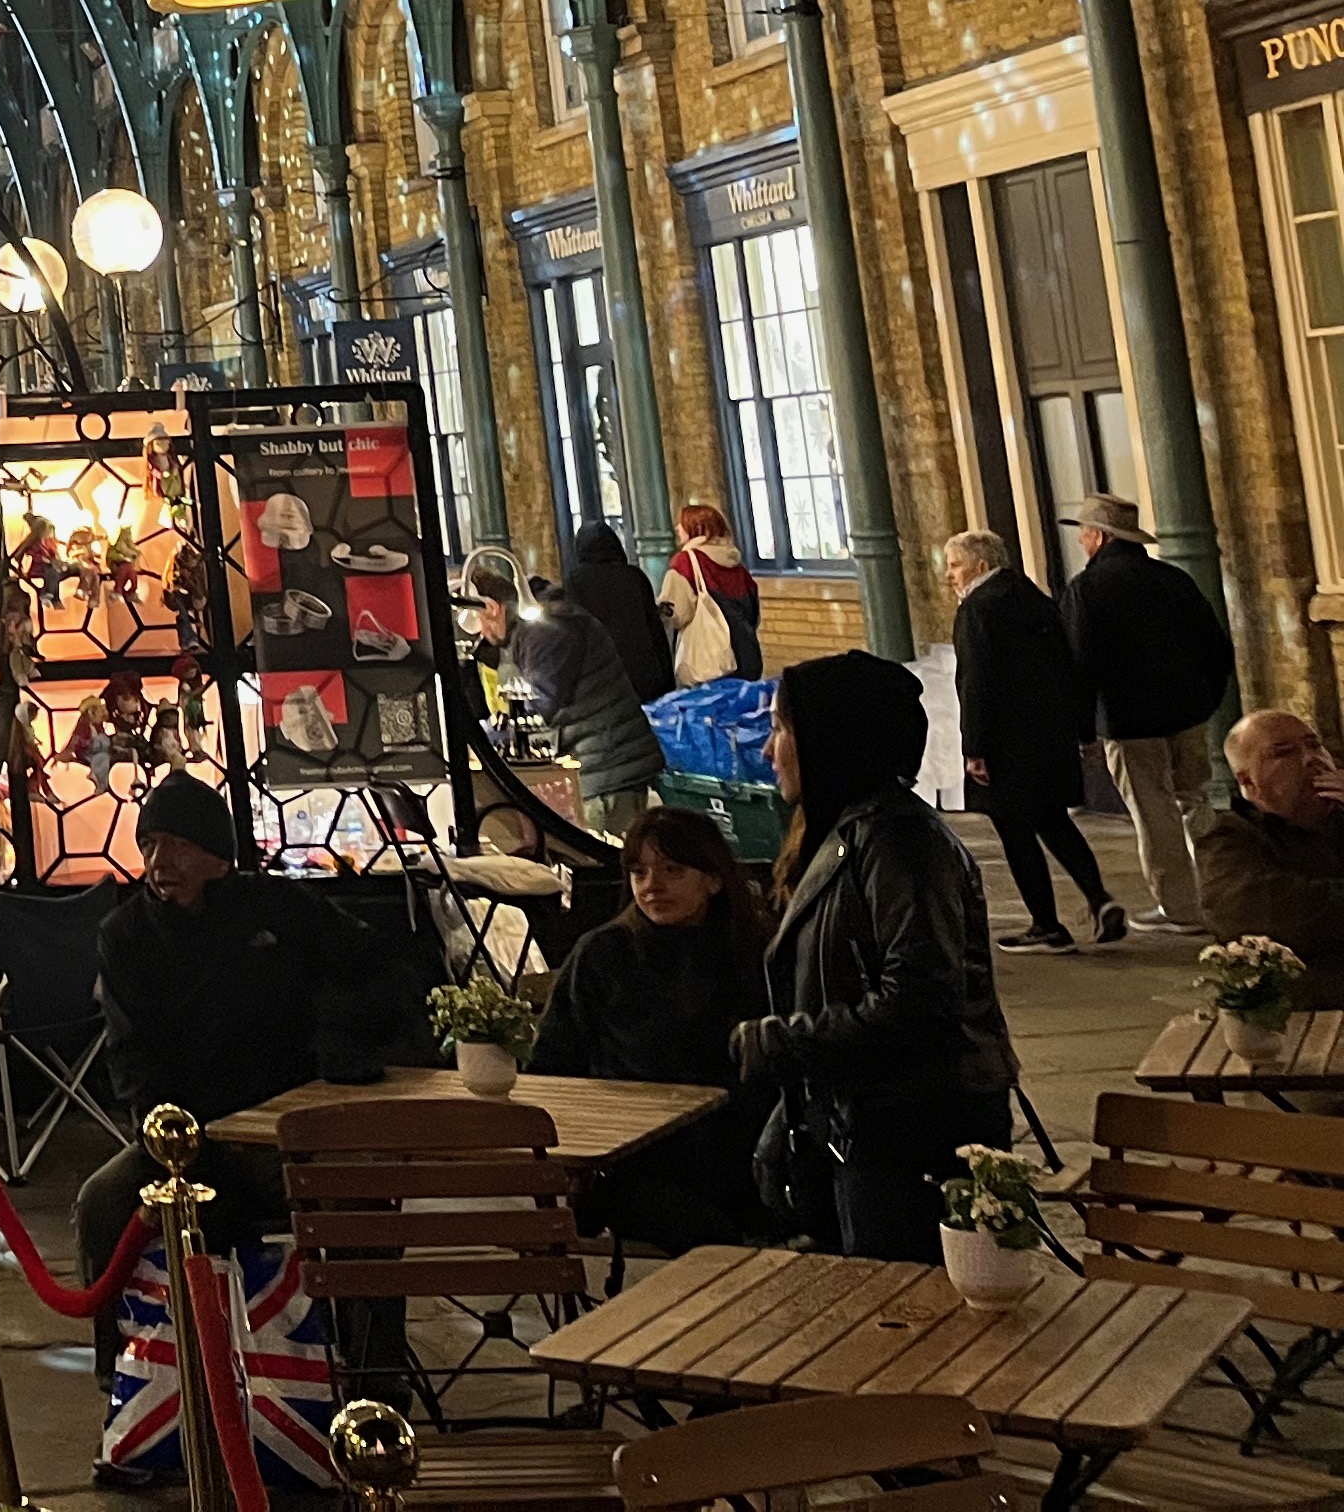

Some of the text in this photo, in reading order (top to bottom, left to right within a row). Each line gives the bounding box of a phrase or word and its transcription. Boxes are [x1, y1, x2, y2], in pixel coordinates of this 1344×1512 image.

[727, 166, 796, 214] Whittard
[345, 365, 412, 384] Whittard
[259, 437, 381, 457] Shabby but chic
